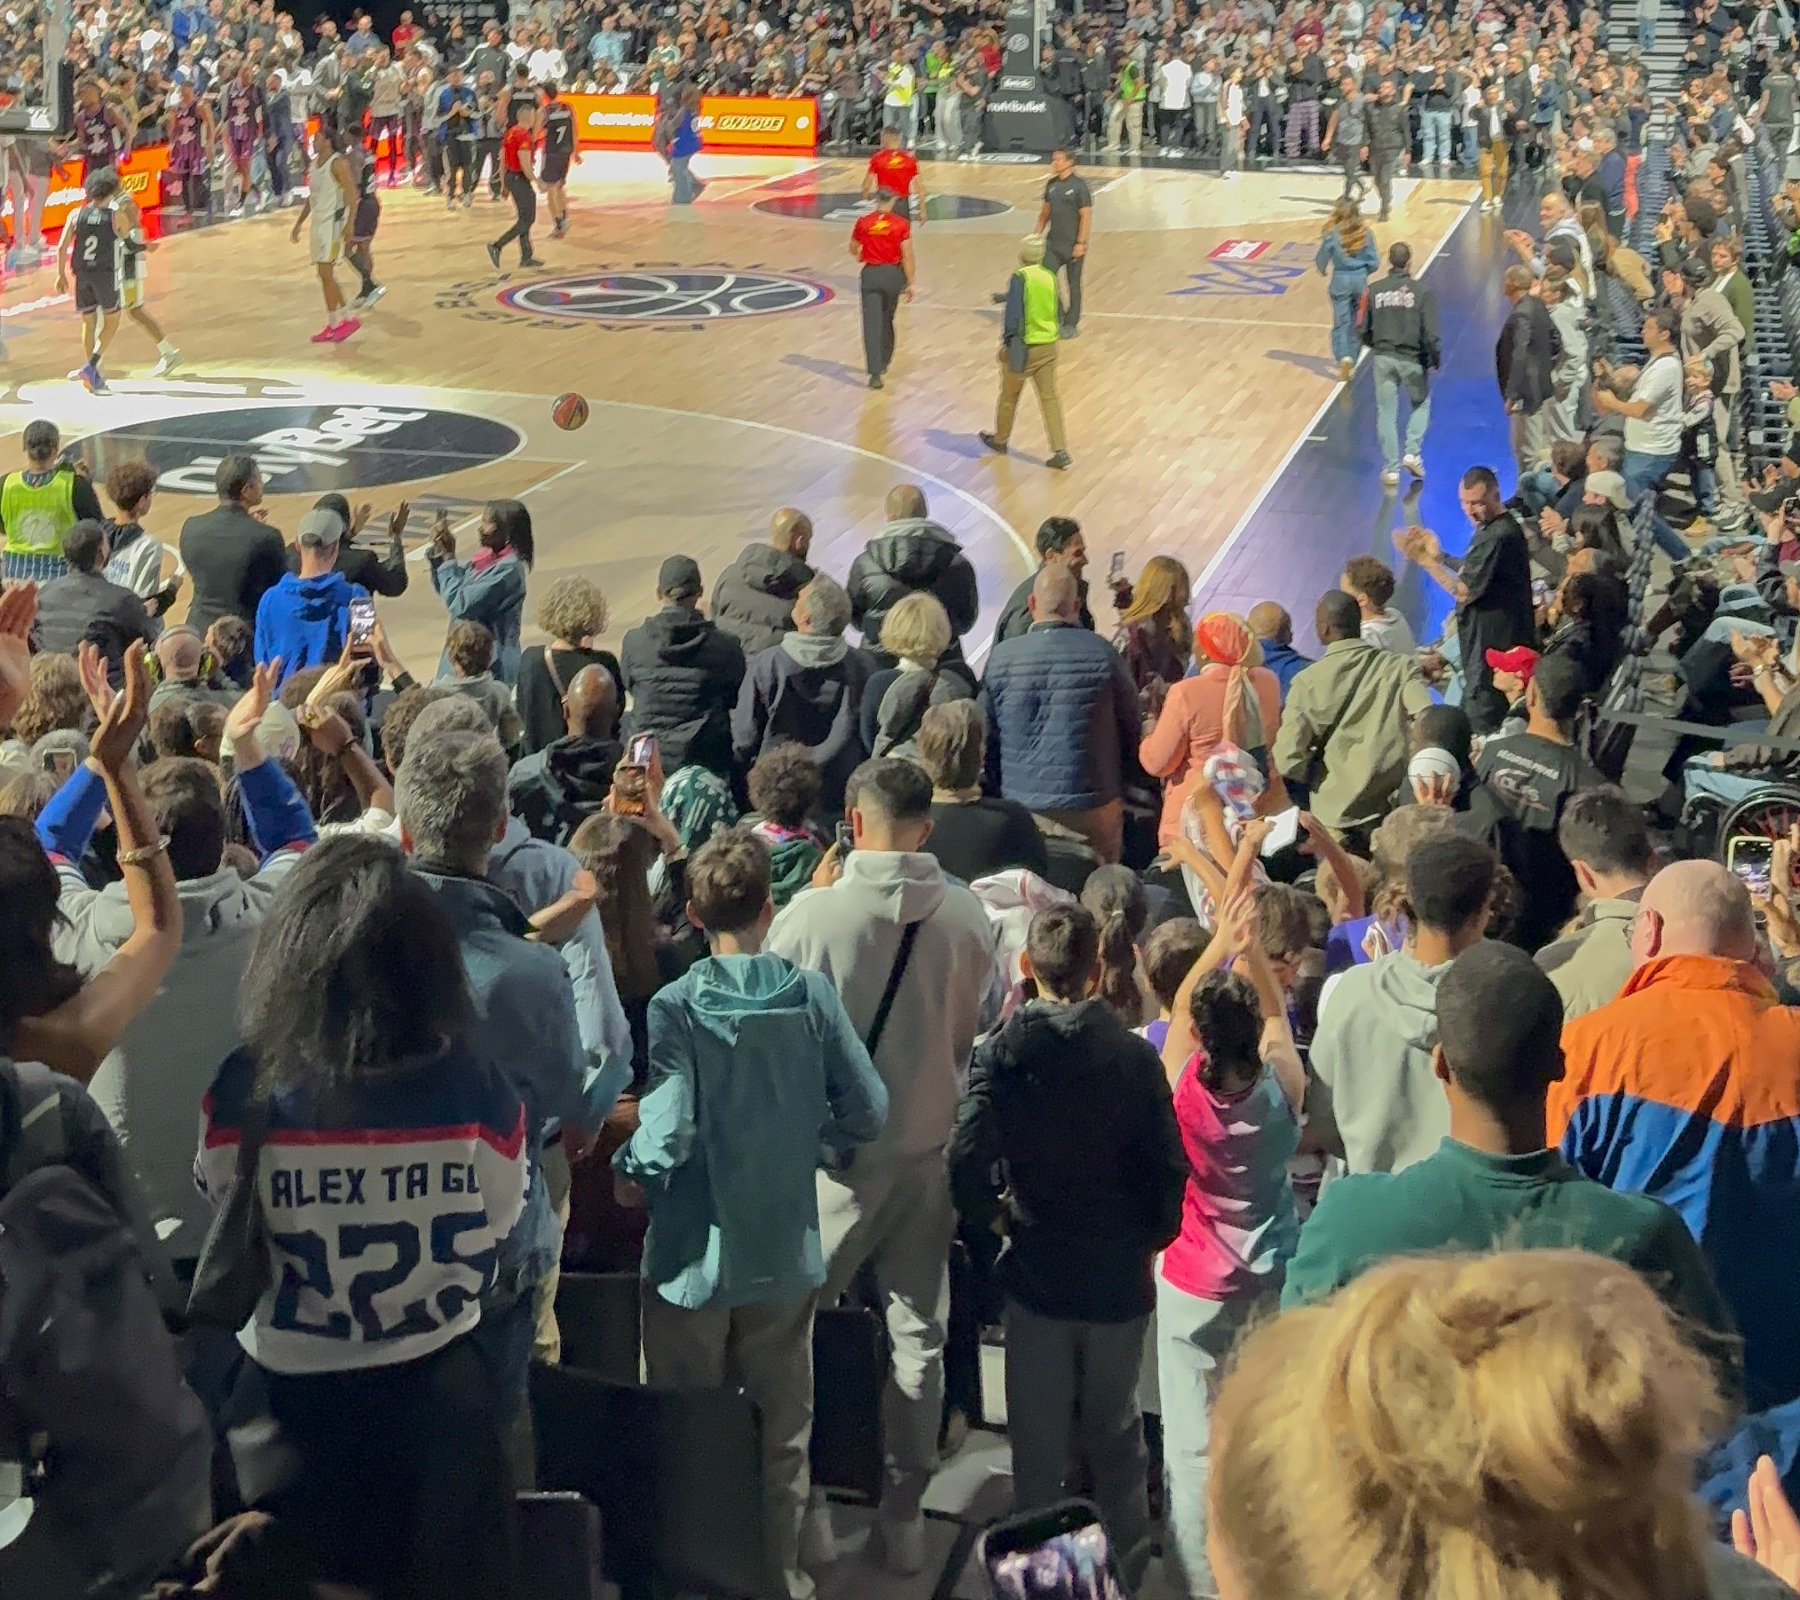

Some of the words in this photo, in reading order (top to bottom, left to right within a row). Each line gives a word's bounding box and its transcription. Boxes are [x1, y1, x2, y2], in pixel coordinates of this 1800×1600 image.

[83, 235, 99, 261] 2
[271, 1168, 366, 1209] ALEX
[381, 1162, 428, 1203] TA
